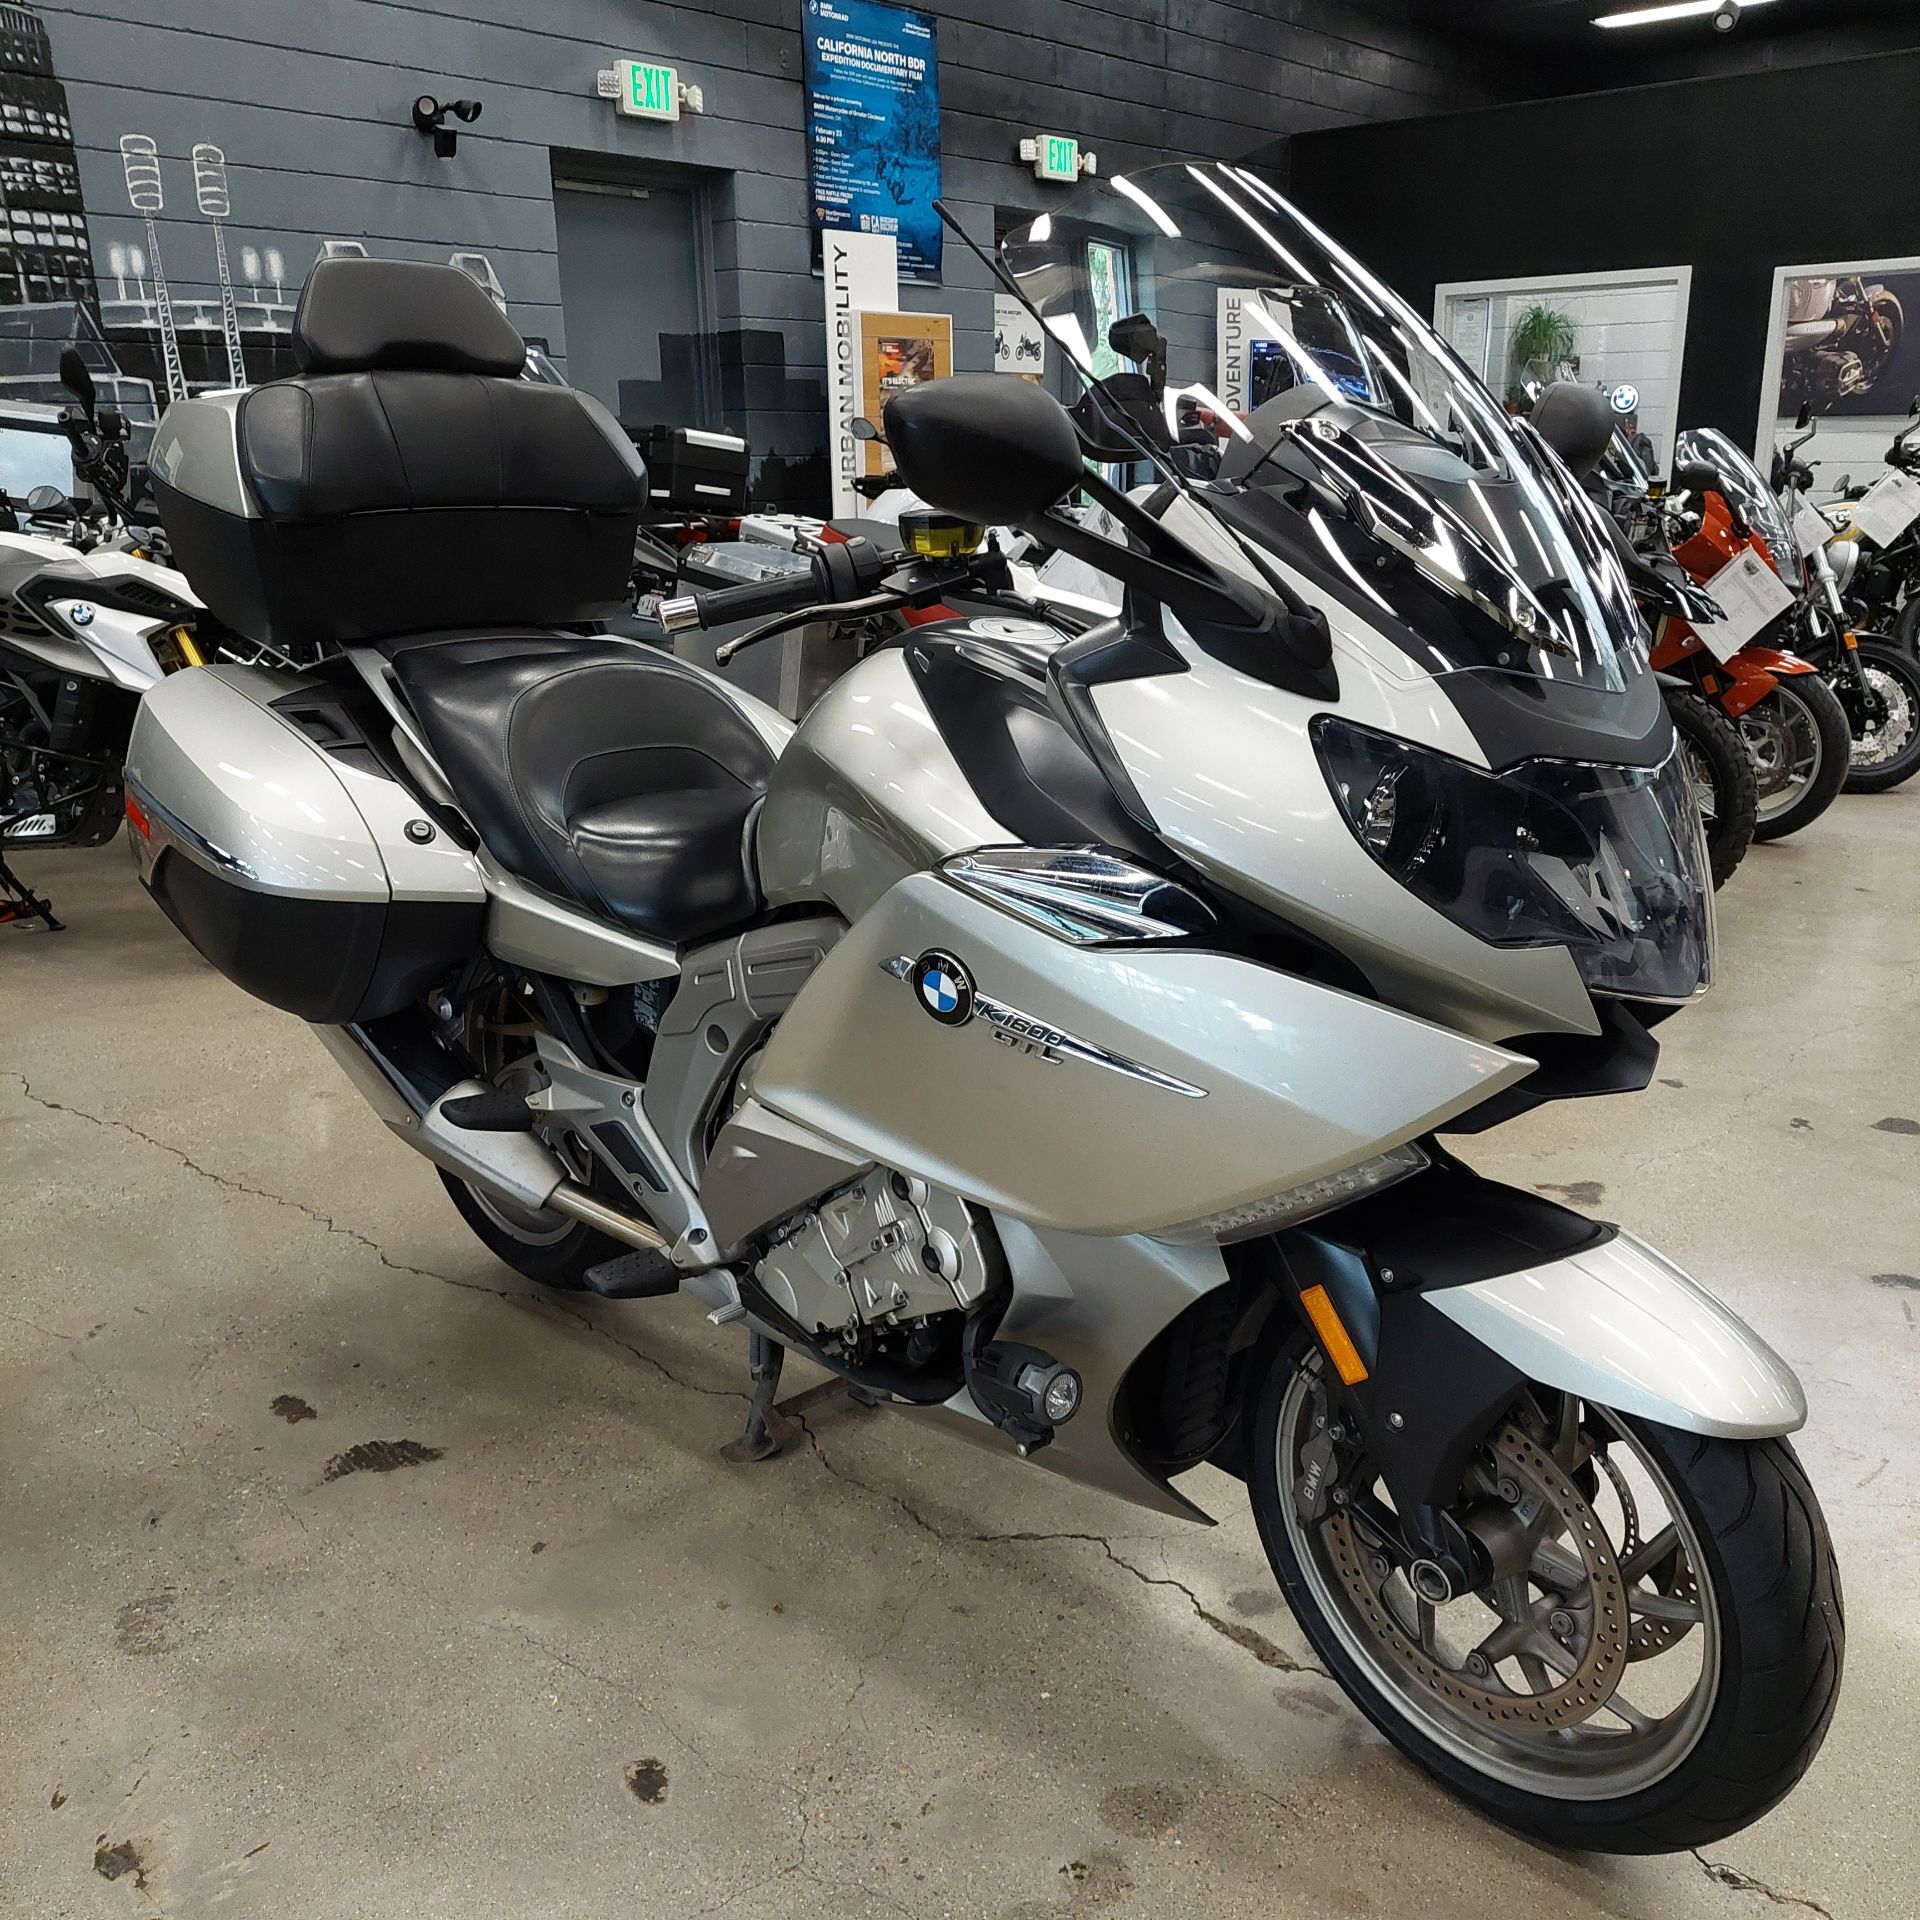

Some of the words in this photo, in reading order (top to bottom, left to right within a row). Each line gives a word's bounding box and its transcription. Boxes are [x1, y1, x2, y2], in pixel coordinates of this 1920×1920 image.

[820, 2, 833, 10] BMW
[820, 9, 849, 21] MOTORRAD
[816, 36, 873, 60] CALIFORNIA
[874, 49, 906, 68] NORTH
[907, 56, 926, 72] BDR
[822, 52, 861, 69] EXPEDITION
[861, 60, 908, 78] DOCUMENTARY
[908, 71, 923, 81] FILM
[632, 65, 670, 112] EXIT
[815, 126, 835, 138] February
[1049, 139, 1074, 172] EXIT
[834, 244, 852, 386] MOBILITY
[1226, 297, 1242, 412] DVENTURE
[839, 396, 856, 492] URBAN
[920, 960, 967, 990] BMW
[988, 1024, 1064, 1066] GTL
[1303, 1459, 1322, 1501] BMW
